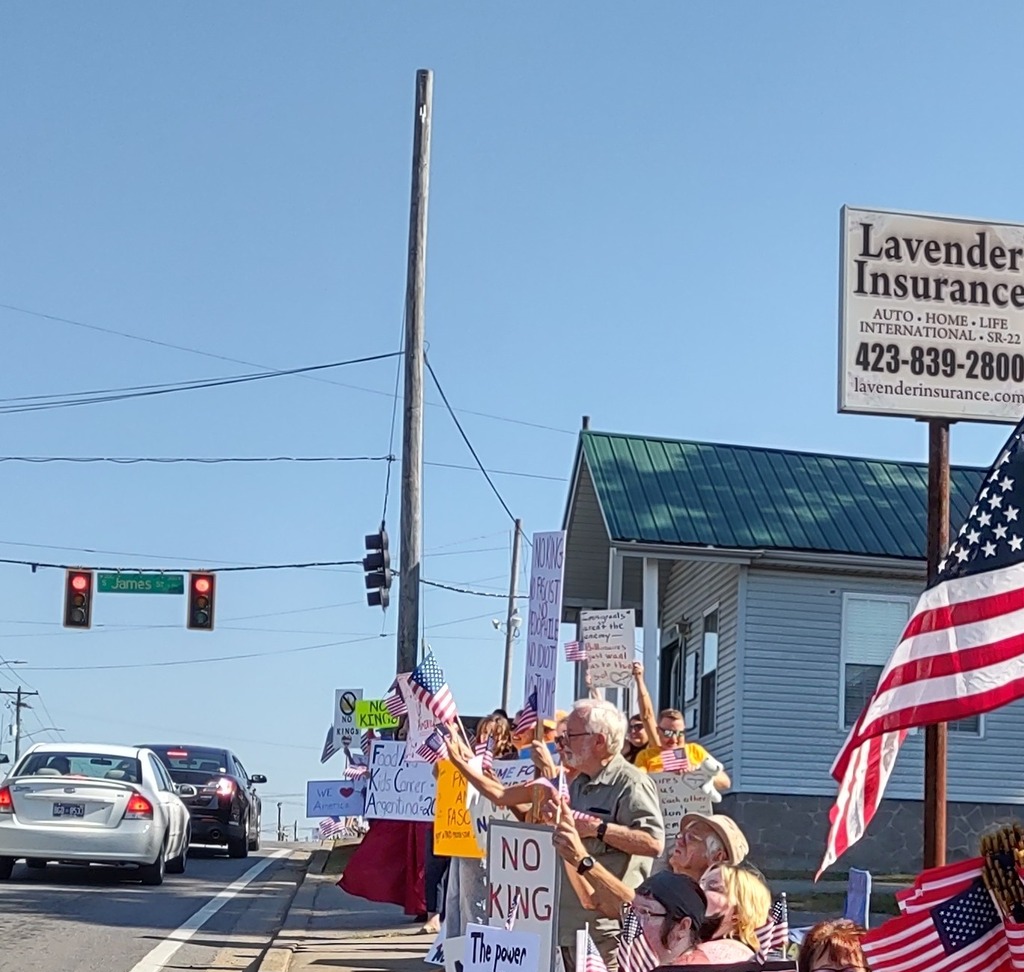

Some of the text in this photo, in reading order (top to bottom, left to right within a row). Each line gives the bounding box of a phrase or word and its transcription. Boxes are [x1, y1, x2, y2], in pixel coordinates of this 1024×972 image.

[858, 222, 1024, 271] Lavender
[873, 308, 1008, 330] AUTO HOME LIFE
[860, 321, 1021, 345] INTERNATIONAL SR-22
[111, 577, 152, 590] James
[336, 728, 359, 736] KINGS
[372, 744, 399, 767] Food
[369, 767, 391, 792] Kids
[516, 764, 535, 777] FO
[317, 788, 333, 798] WE
[447, 808, 471, 826] FASC
[501, 837, 541, 871] NO
[488, 882, 552, 921] KING
[470, 932, 491, 964] The
